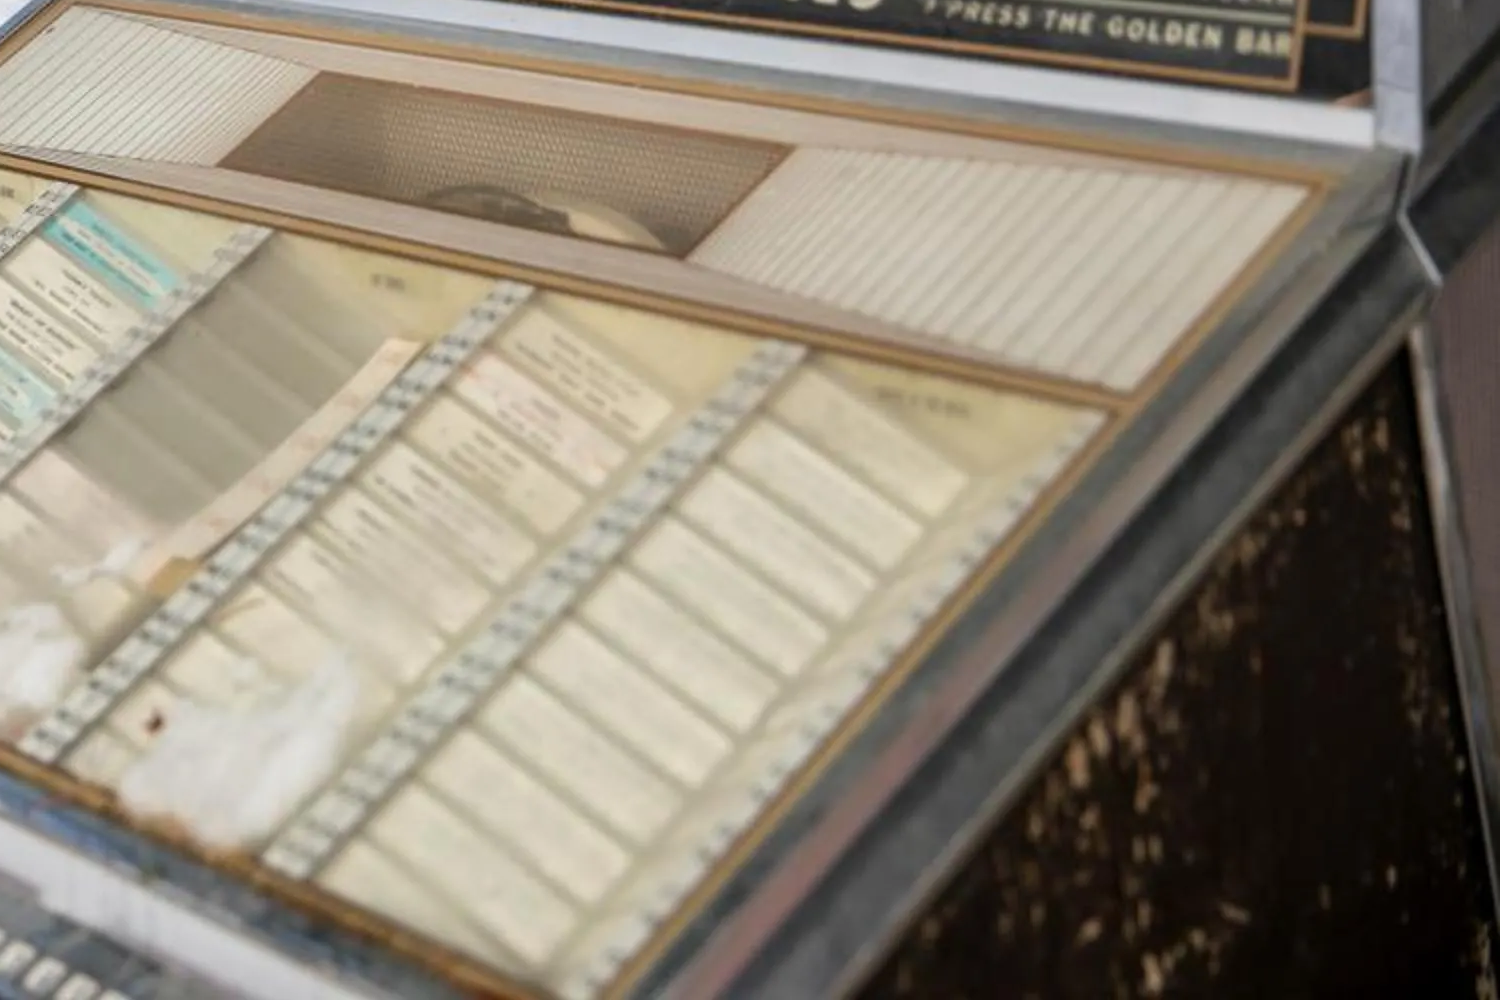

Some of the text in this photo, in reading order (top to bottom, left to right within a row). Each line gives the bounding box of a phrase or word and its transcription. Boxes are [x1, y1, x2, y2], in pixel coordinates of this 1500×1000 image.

[1043, 7, 1095, 37] THE
[1106, 14, 1223, 52] GOLDEN
[1234, 27, 1291, 59] BAR
